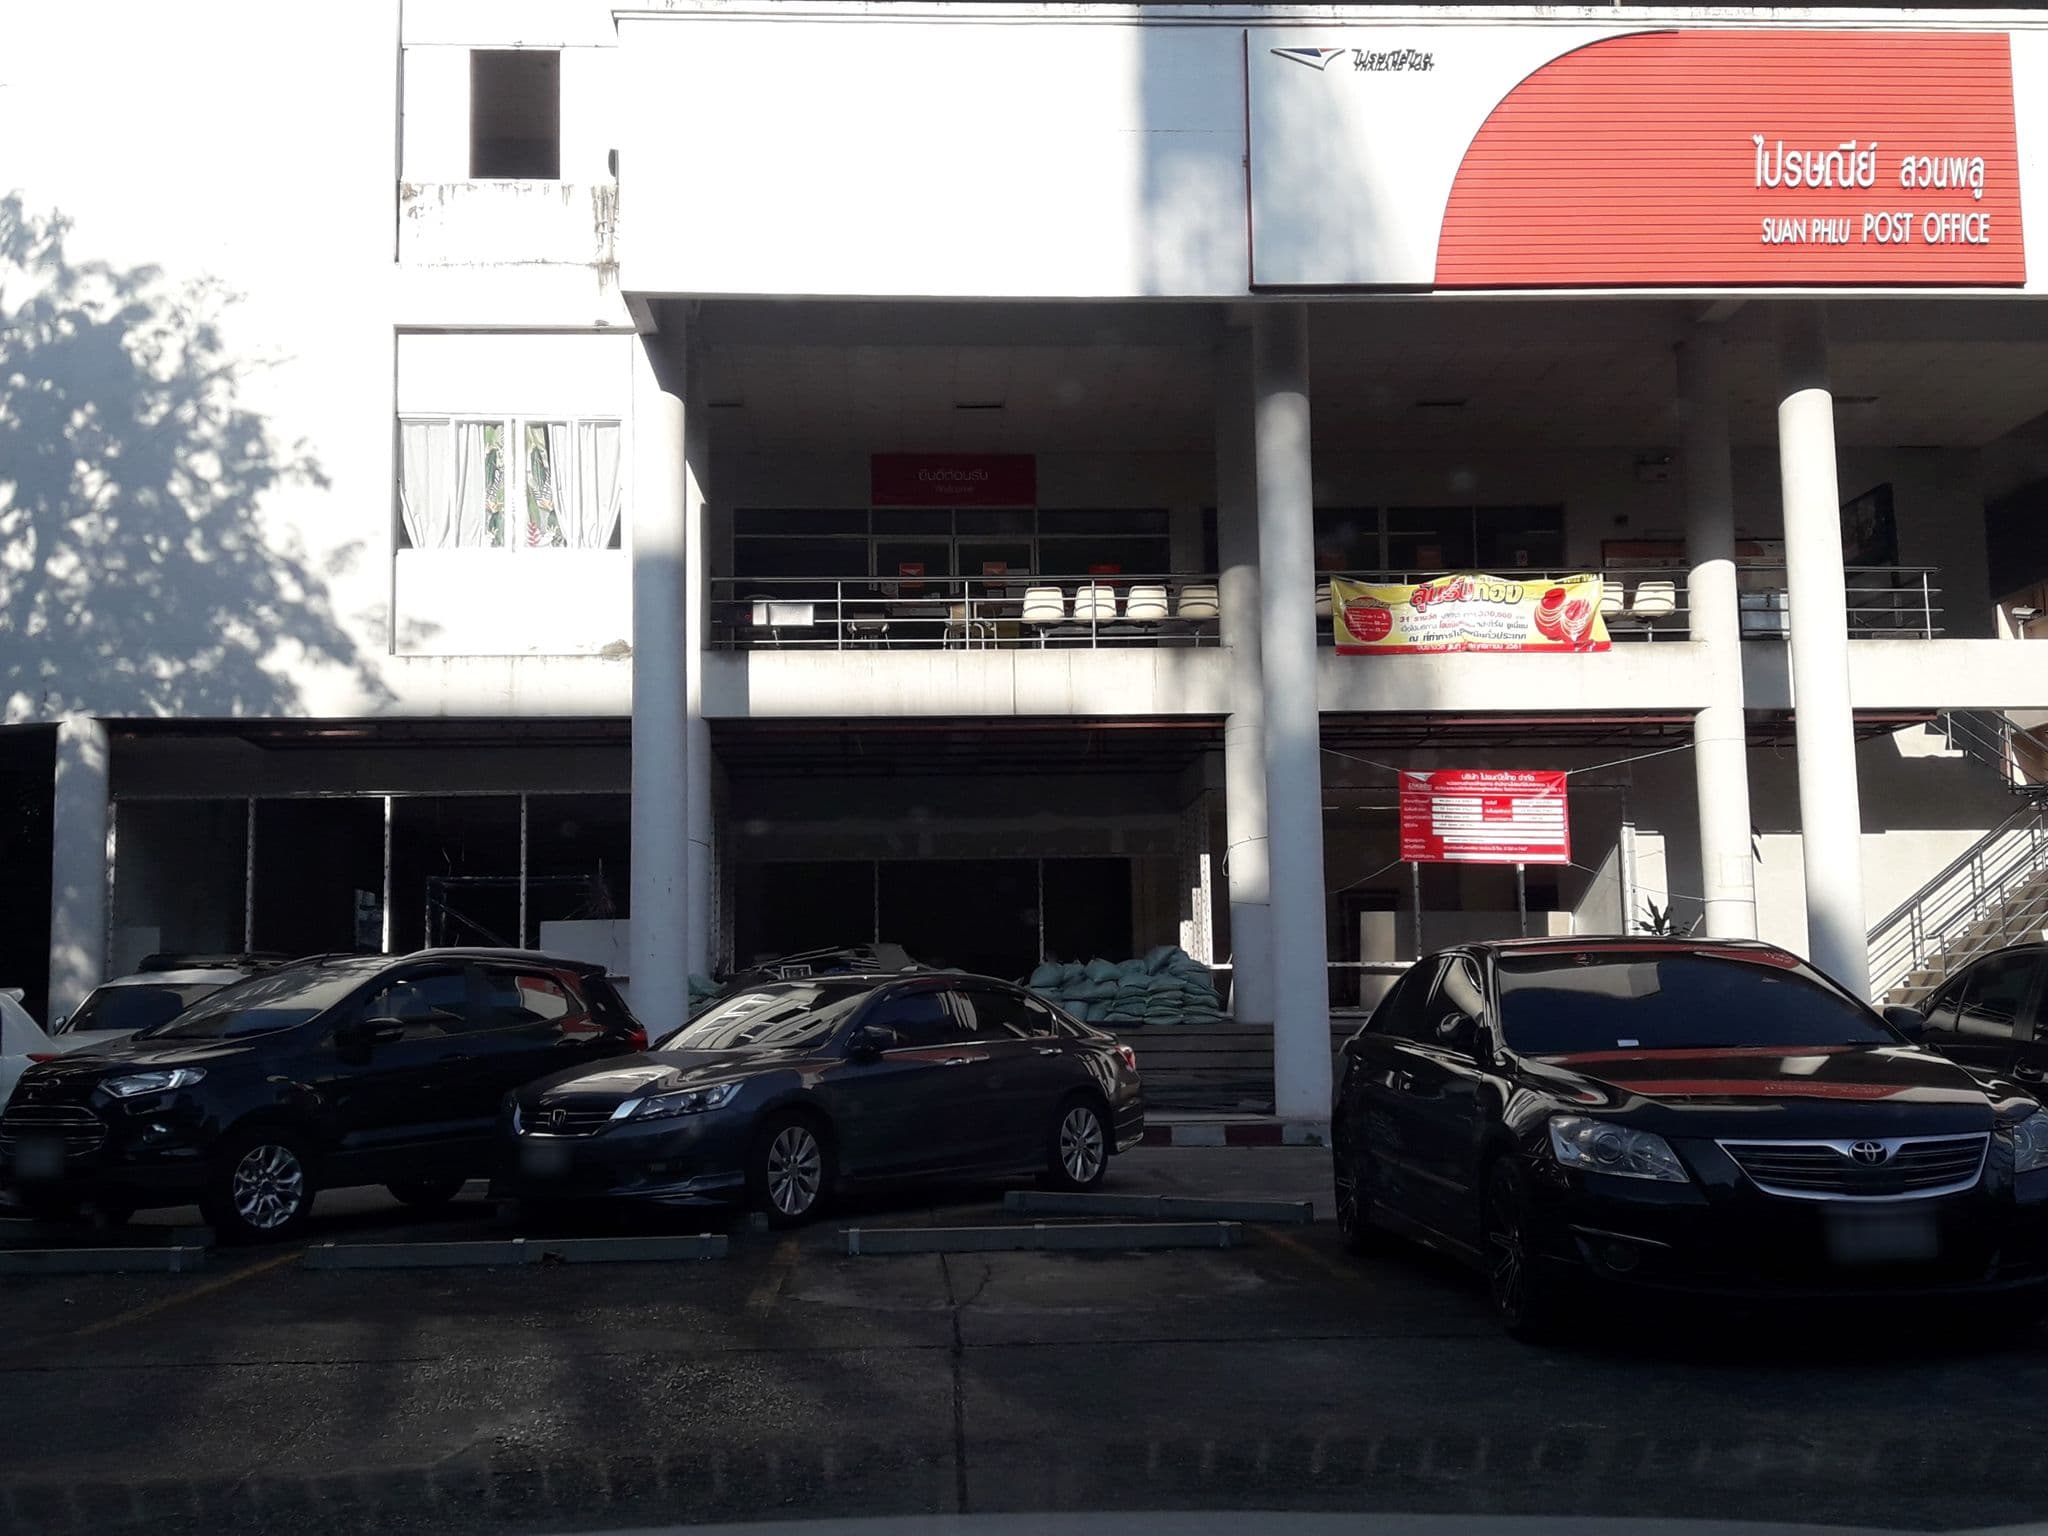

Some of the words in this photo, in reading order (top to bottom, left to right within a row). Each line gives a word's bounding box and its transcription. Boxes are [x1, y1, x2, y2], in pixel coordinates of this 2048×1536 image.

[1354, 62, 1403, 72] THAILAND
[1408, 62, 1435, 72] POST
[1752, 133, 1878, 189] ไปรษณีย์
[1900, 154, 1986, 200] สวนพลู
[1761, 217, 1807, 244] SUAN
[1811, 217, 1851, 244] PHLU
[1862, 212, 1914, 245] POST
[1922, 211, 1991, 244] OFFICE
